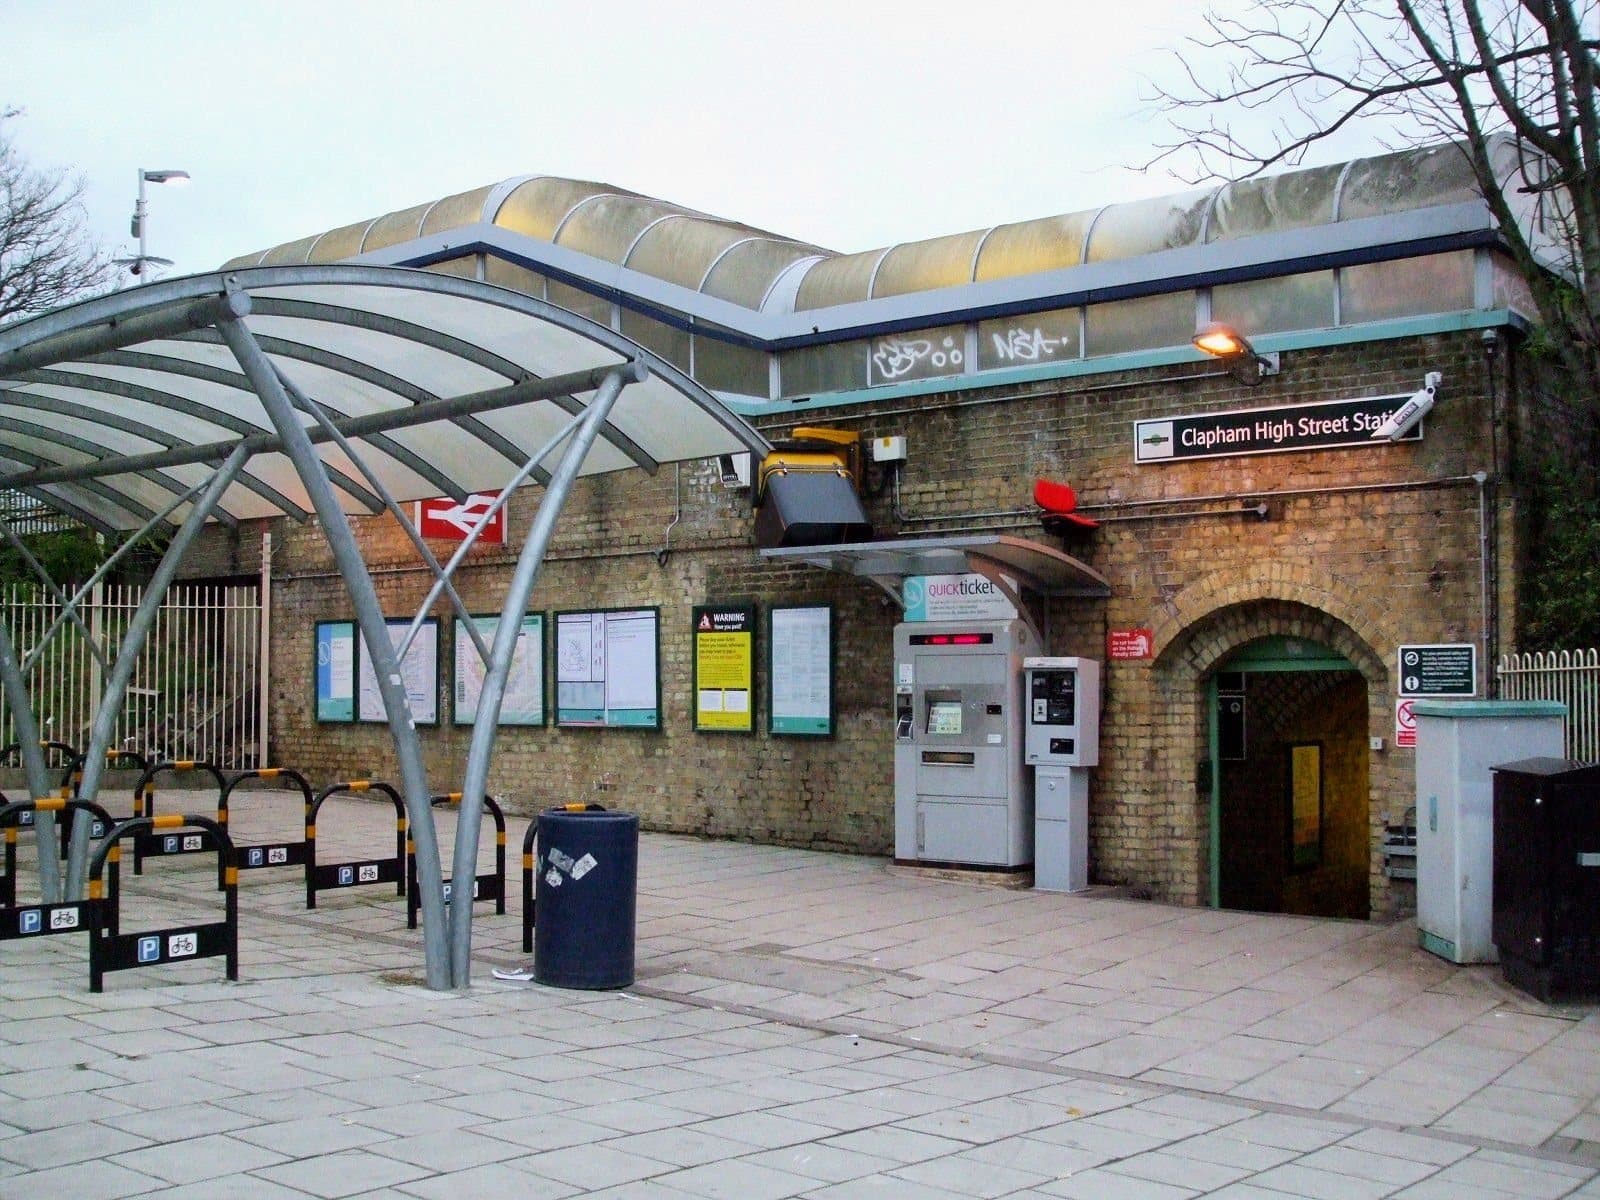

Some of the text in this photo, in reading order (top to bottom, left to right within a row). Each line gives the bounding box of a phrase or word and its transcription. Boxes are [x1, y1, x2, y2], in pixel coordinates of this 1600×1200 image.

[1181, 425, 1250, 448] Clapham
[1255, 419, 1294, 443] High
[1298, 416, 1349, 437] Street
[713, 613, 745, 622] WARNING
[167, 838, 175, 850] P
[252, 850, 260, 864] P
[342, 868, 350, 882] P
[25, 913, 37, 930] P
[143, 941, 155, 959] P
